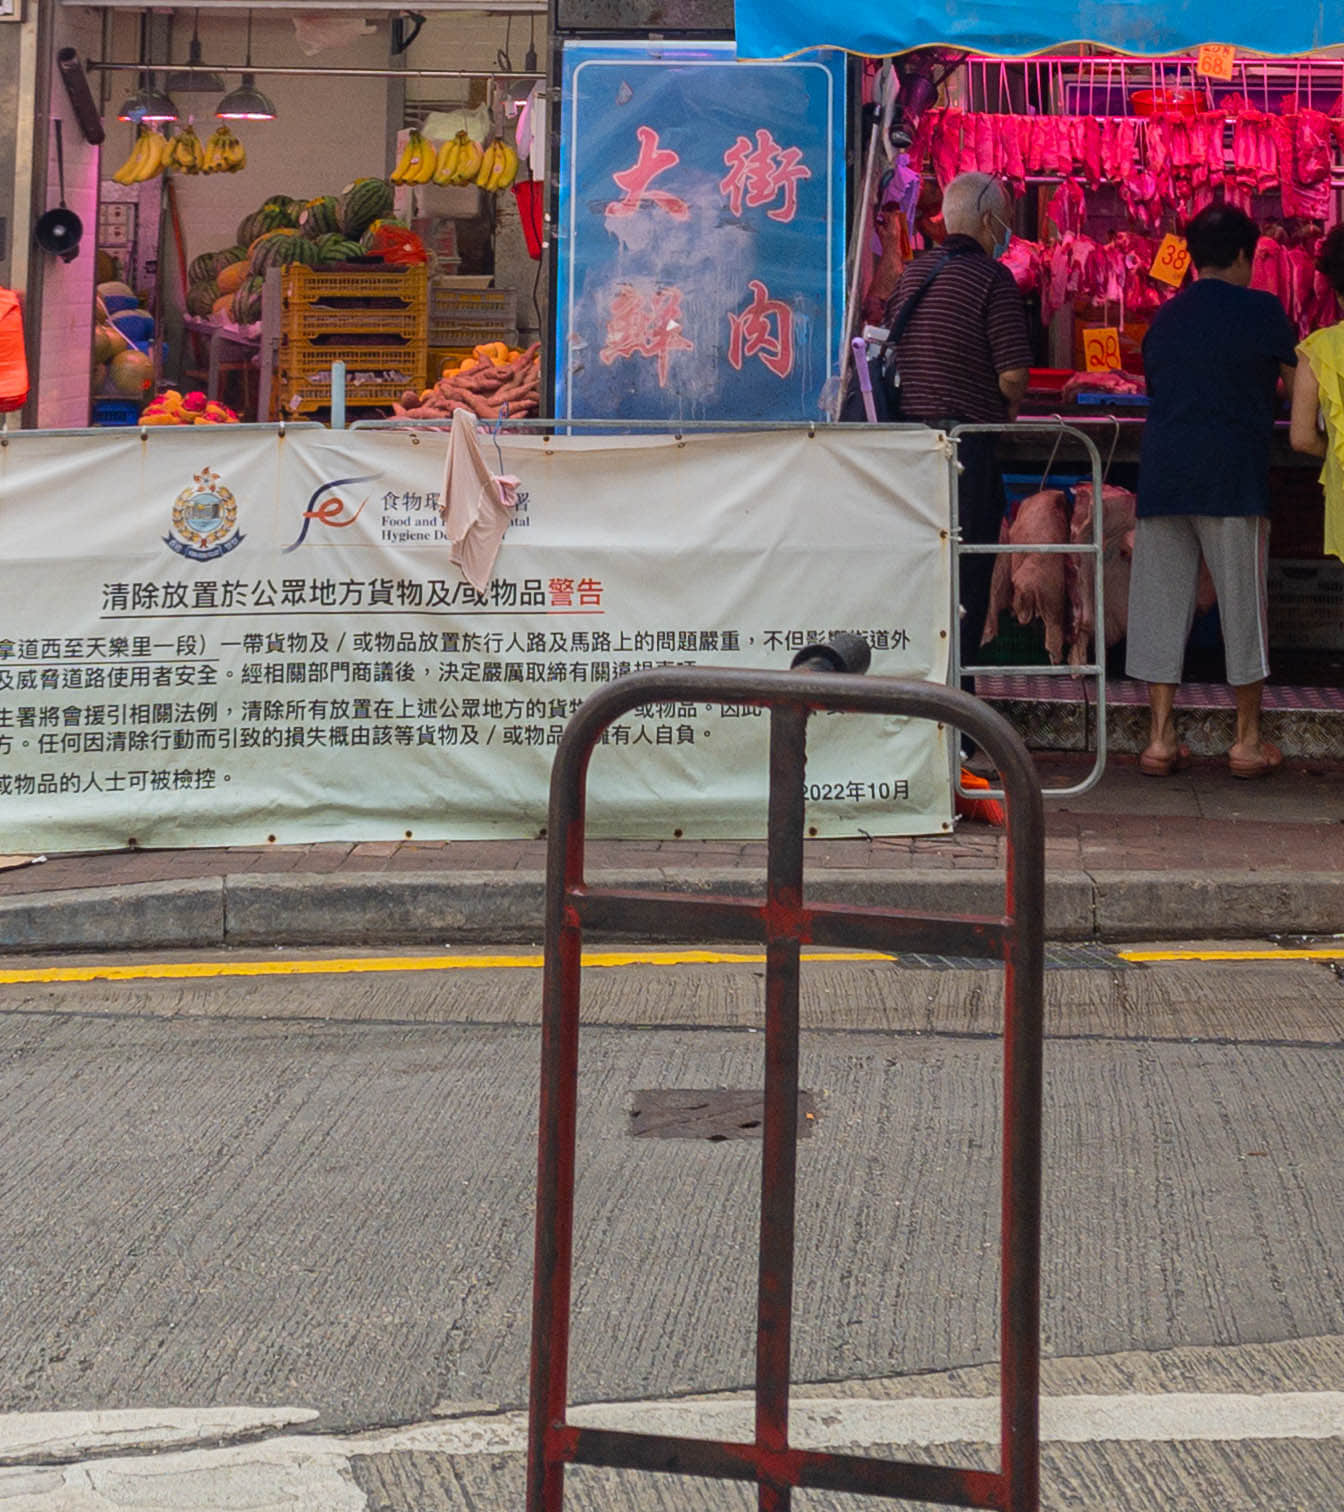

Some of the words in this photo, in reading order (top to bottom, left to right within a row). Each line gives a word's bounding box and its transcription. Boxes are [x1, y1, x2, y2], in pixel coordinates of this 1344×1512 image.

[1201, 55, 1224, 75] 68
[604, 124, 812, 223] 大街
[1162, 245, 1188, 271] 38
[599, 279, 795, 388] 鮮肉
[1087, 335, 1120, 370] 28
[382, 515, 411, 527] Food
[414, 515, 437, 527] and
[382, 529, 431, 544] Hygiene
[802, 779, 910, 803] 2022年10月
